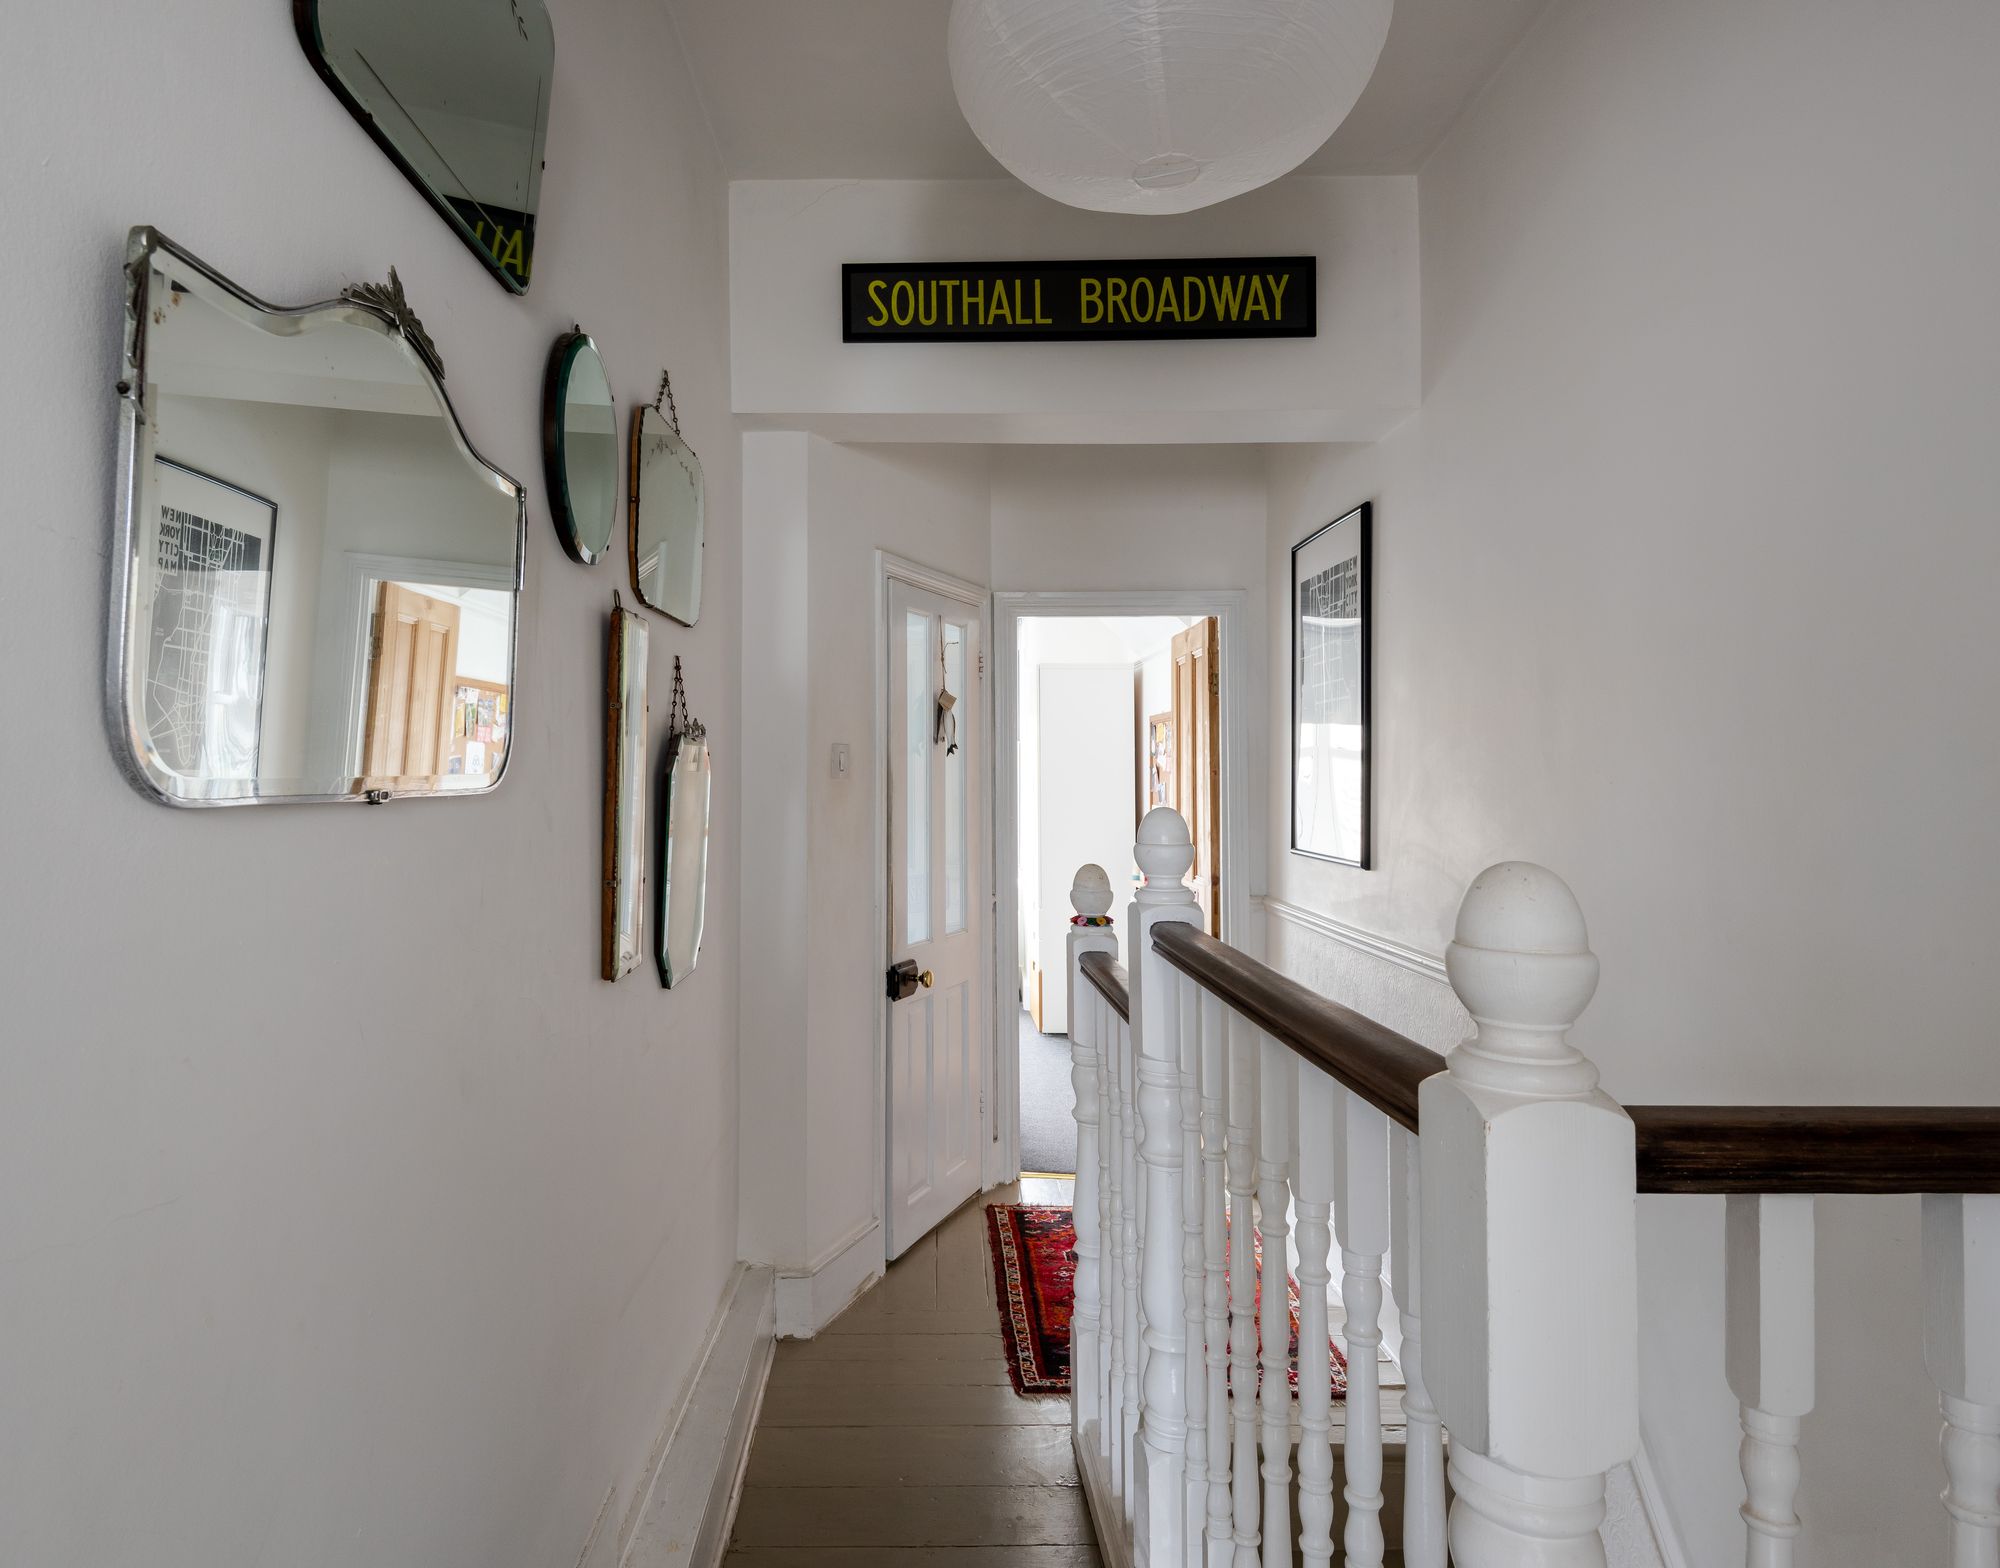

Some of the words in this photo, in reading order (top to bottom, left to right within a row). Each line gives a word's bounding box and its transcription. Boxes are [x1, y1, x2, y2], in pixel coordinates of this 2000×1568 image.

[866, 279, 1052, 326] SOUTHALL
[1080, 274, 1289, 323] BROADWAY
[1345, 590, 1358, 607] CITY
